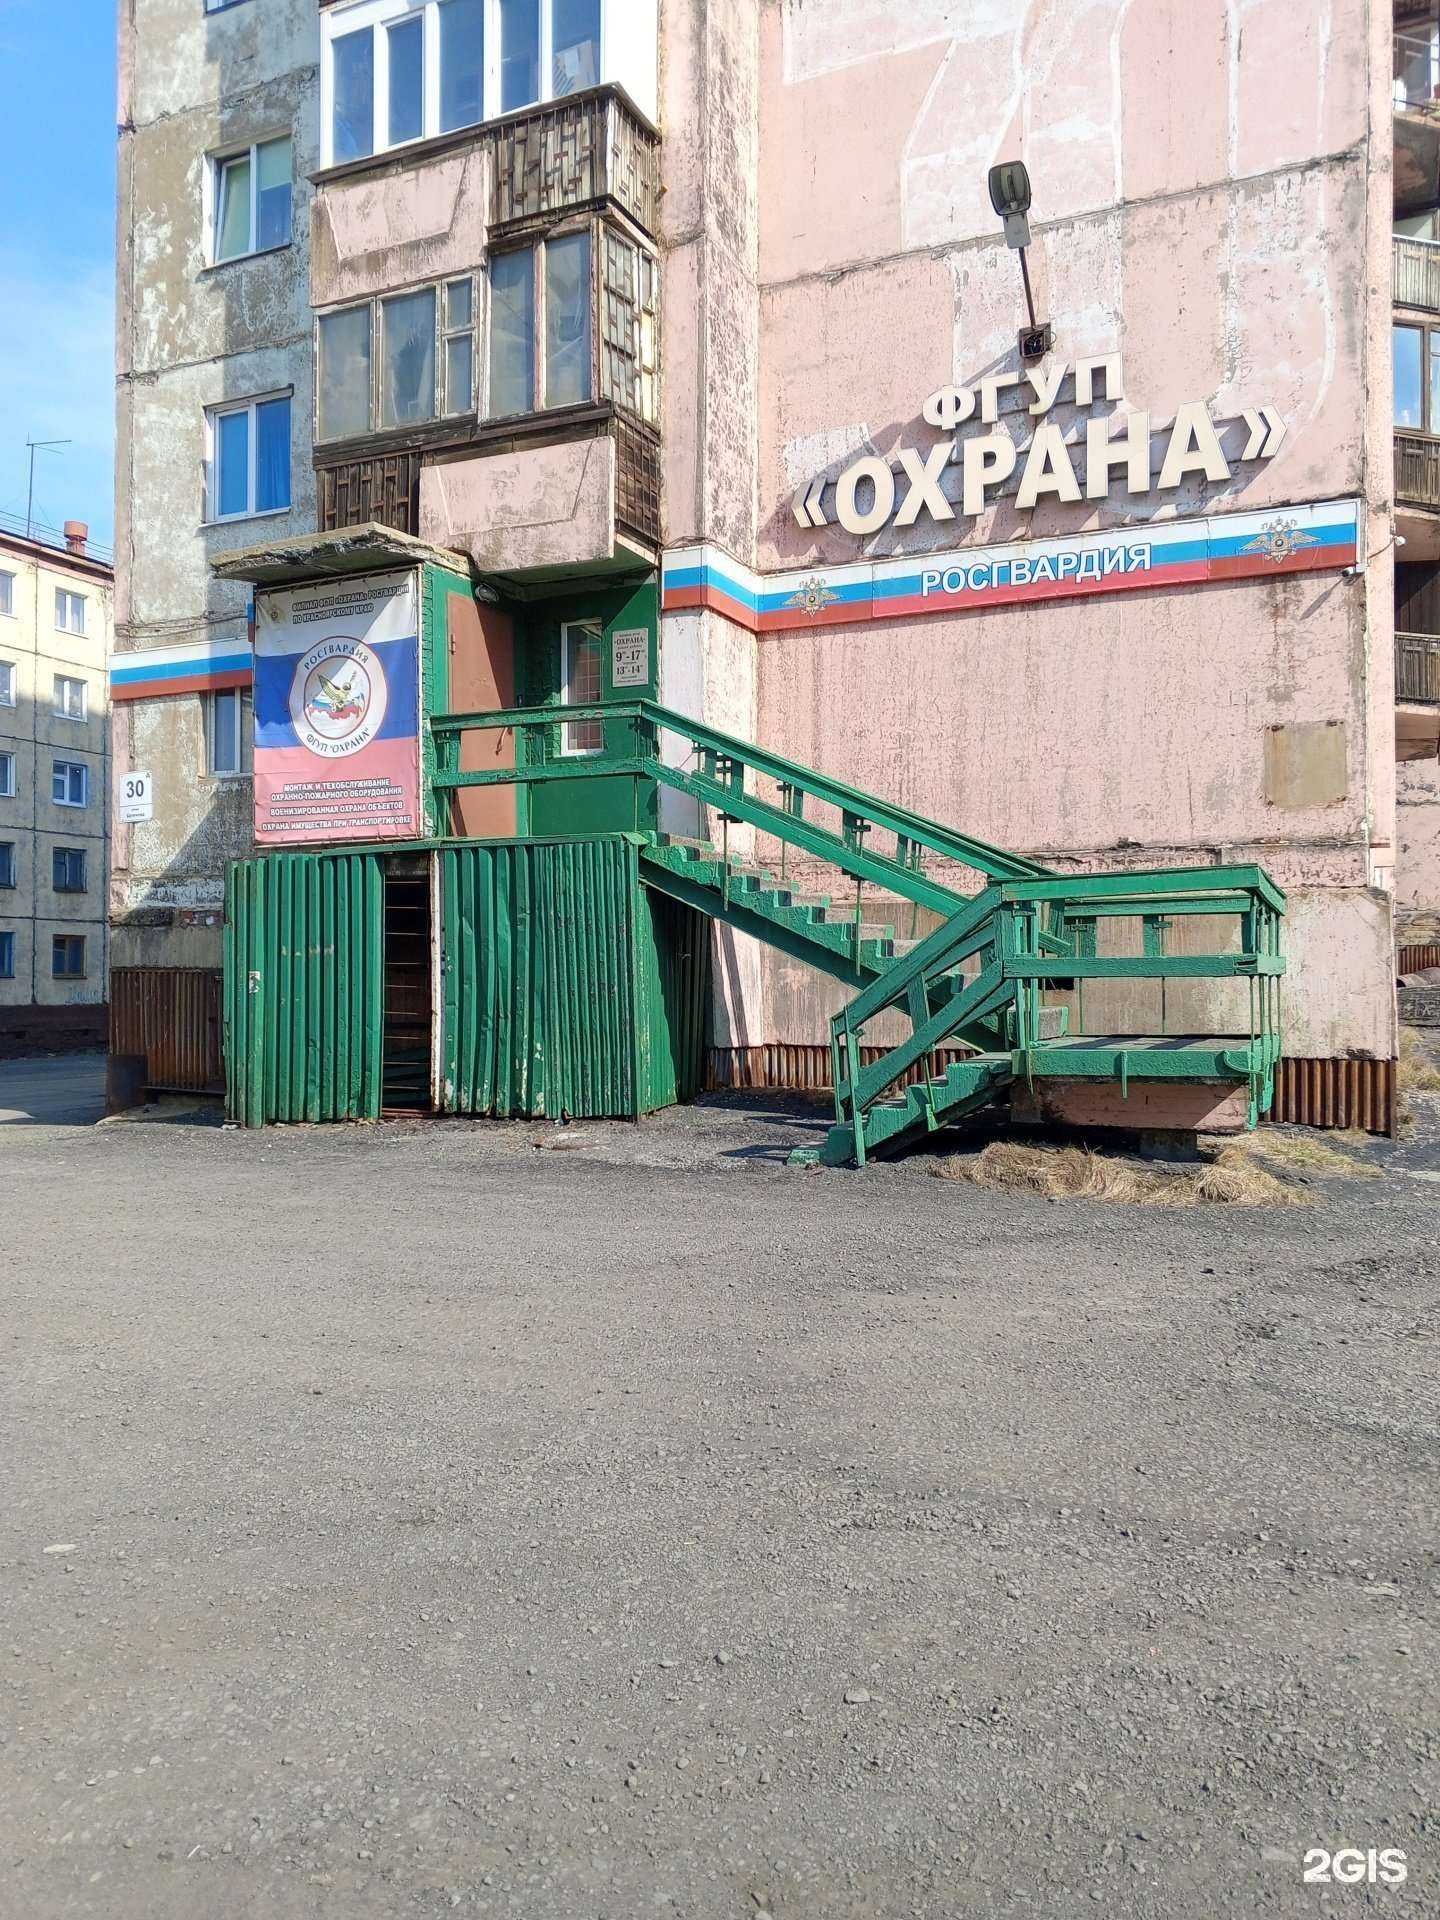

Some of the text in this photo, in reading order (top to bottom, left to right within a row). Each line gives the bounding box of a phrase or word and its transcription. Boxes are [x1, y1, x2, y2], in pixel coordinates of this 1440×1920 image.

[922, 351, 1124, 430] ФГУП
[791, 401, 1288, 535] «ОХРАНА»
[921, 543, 1152, 597] РОСГВАРДИЯ
[293, 614, 302, 624] ПО
[304, 644, 369, 670] РОСГВАРДИЯ
[126, 780, 144, 798] 30
[284, 783, 313, 792] МОНТАЖ
[322, 778, 390, 790] ТЕХОБСЛУЖИВАНИЕ
[271, 787, 402, 801] ОХРАННО-ПОЖАРНОГО ОБОРУДОВАНИЯ
[270, 801, 403, 816] ВОЕНИЗИРОВАННАЯ ОХРАНА ОБЪЕКТОВ
[262, 822, 290, 831] ОХРАНА
[291, 820, 332, 830] ИМУЩЕСТВА
[349, 815, 412, 826] ТРАНСПОРТИРОВКЕ
